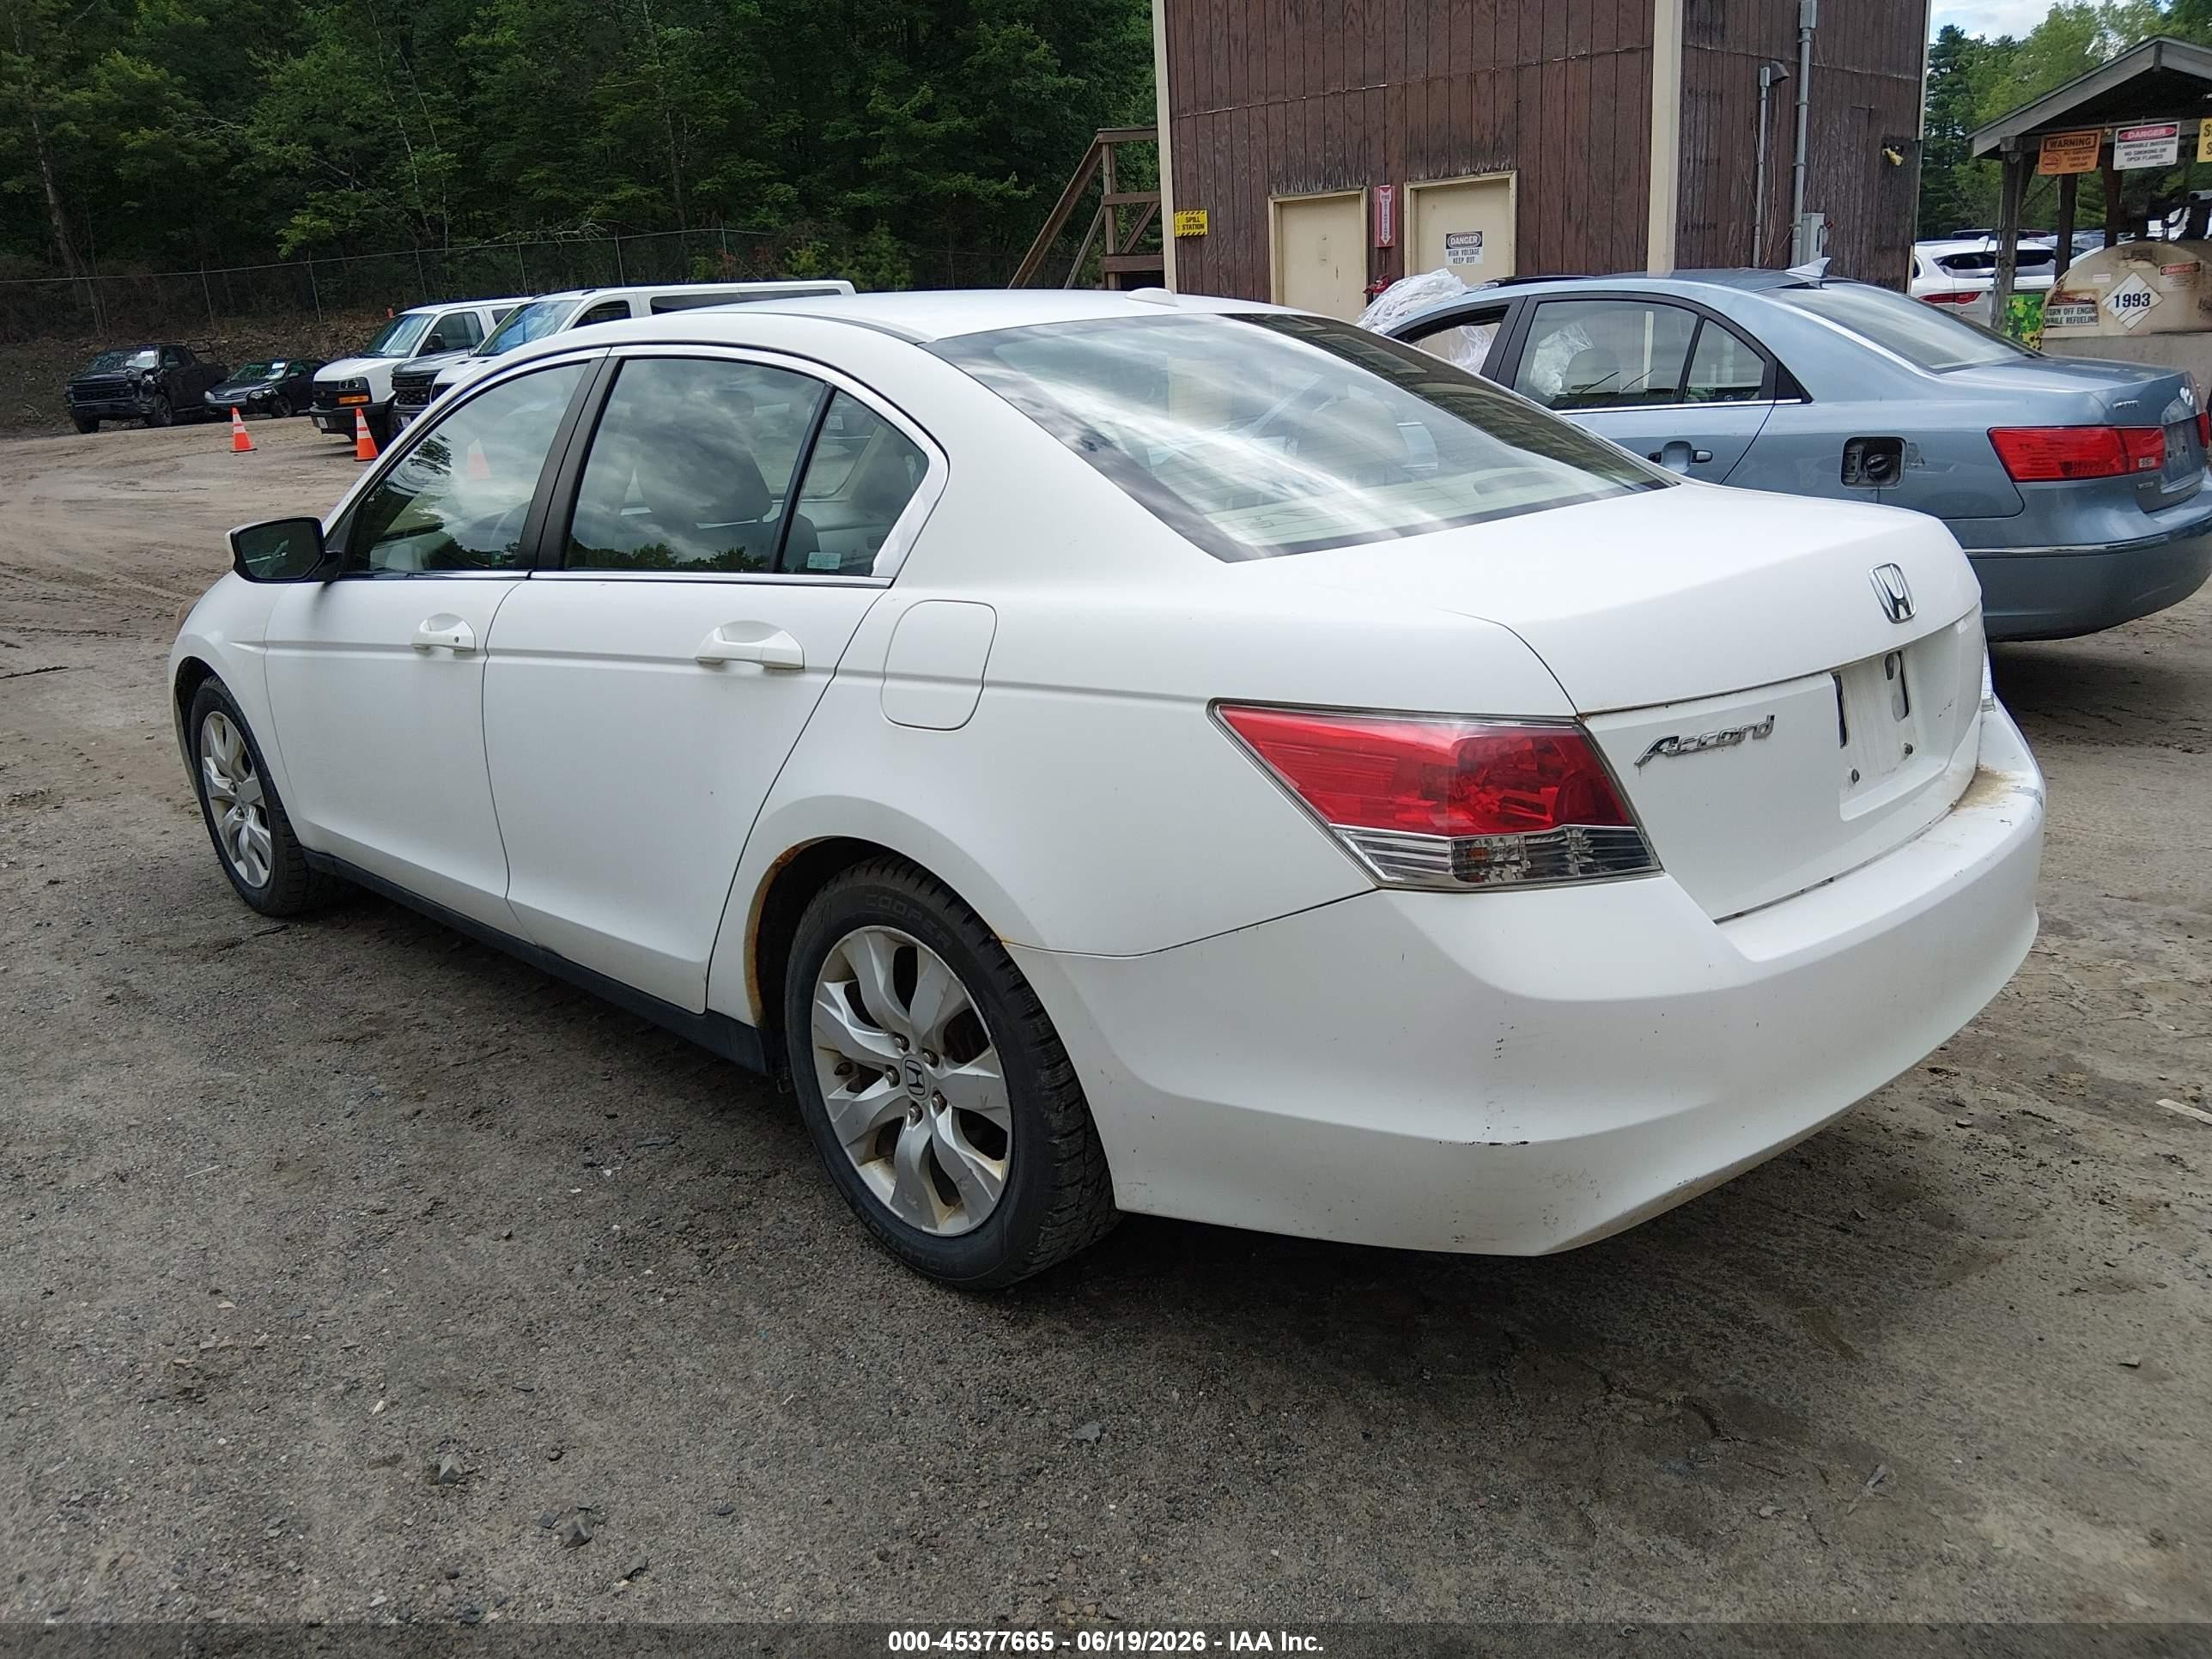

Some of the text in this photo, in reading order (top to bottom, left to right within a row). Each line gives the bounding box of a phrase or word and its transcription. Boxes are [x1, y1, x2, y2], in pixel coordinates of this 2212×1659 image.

[2128, 129, 2166, 139] DANGER
[2048, 137, 2091, 149] WARNING
[1450, 235, 1478, 246] DANGER
[2114, 293, 2151, 308] 1993
[1633, 714, 1775, 767] Accord
